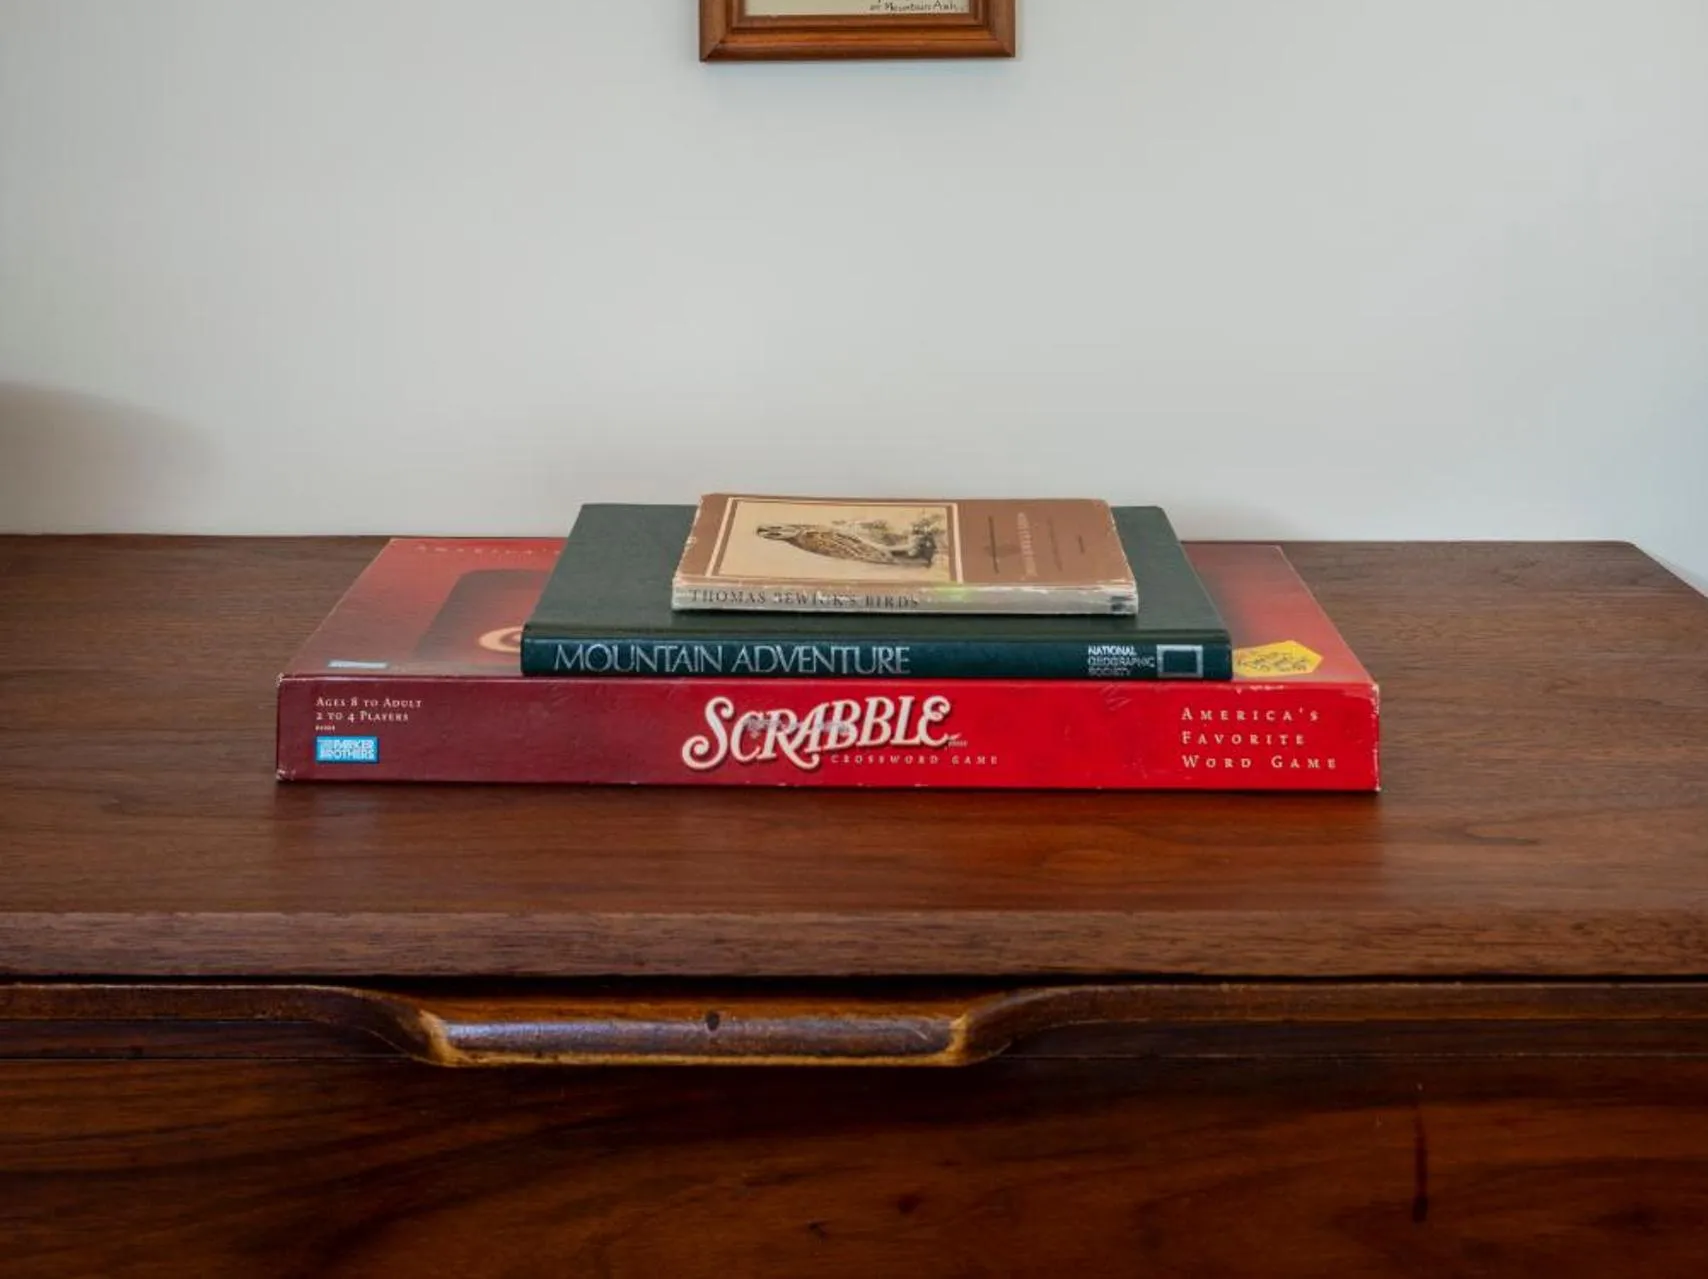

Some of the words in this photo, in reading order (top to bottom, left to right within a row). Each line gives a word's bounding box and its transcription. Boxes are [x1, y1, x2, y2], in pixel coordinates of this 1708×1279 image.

[688, 588, 767, 605] THOMAS
[1087, 644, 1138, 656] NATIONAL
[553, 643, 723, 672] MOUNTAIN
[729, 645, 912, 675] ADVENTURE
[316, 697, 346, 708] AGES
[350, 696, 358, 707] 8
[363, 699, 379, 708] TO
[383, 698, 423, 709] ADULT
[315, 712, 323, 721] 2
[327, 712, 343, 721] TO
[347, 712, 355, 723] 4
[360, 711, 409, 722] PLAYERS
[1181, 707, 1320, 722] AMERICA'S
[1181, 730, 1305, 746] FAVORITE
[830, 754, 940, 765] CROSSWORD
[951, 756, 998, 766] GAME
[1181, 754, 1252, 770] WORD
[1271, 755, 1337, 770] GAME
